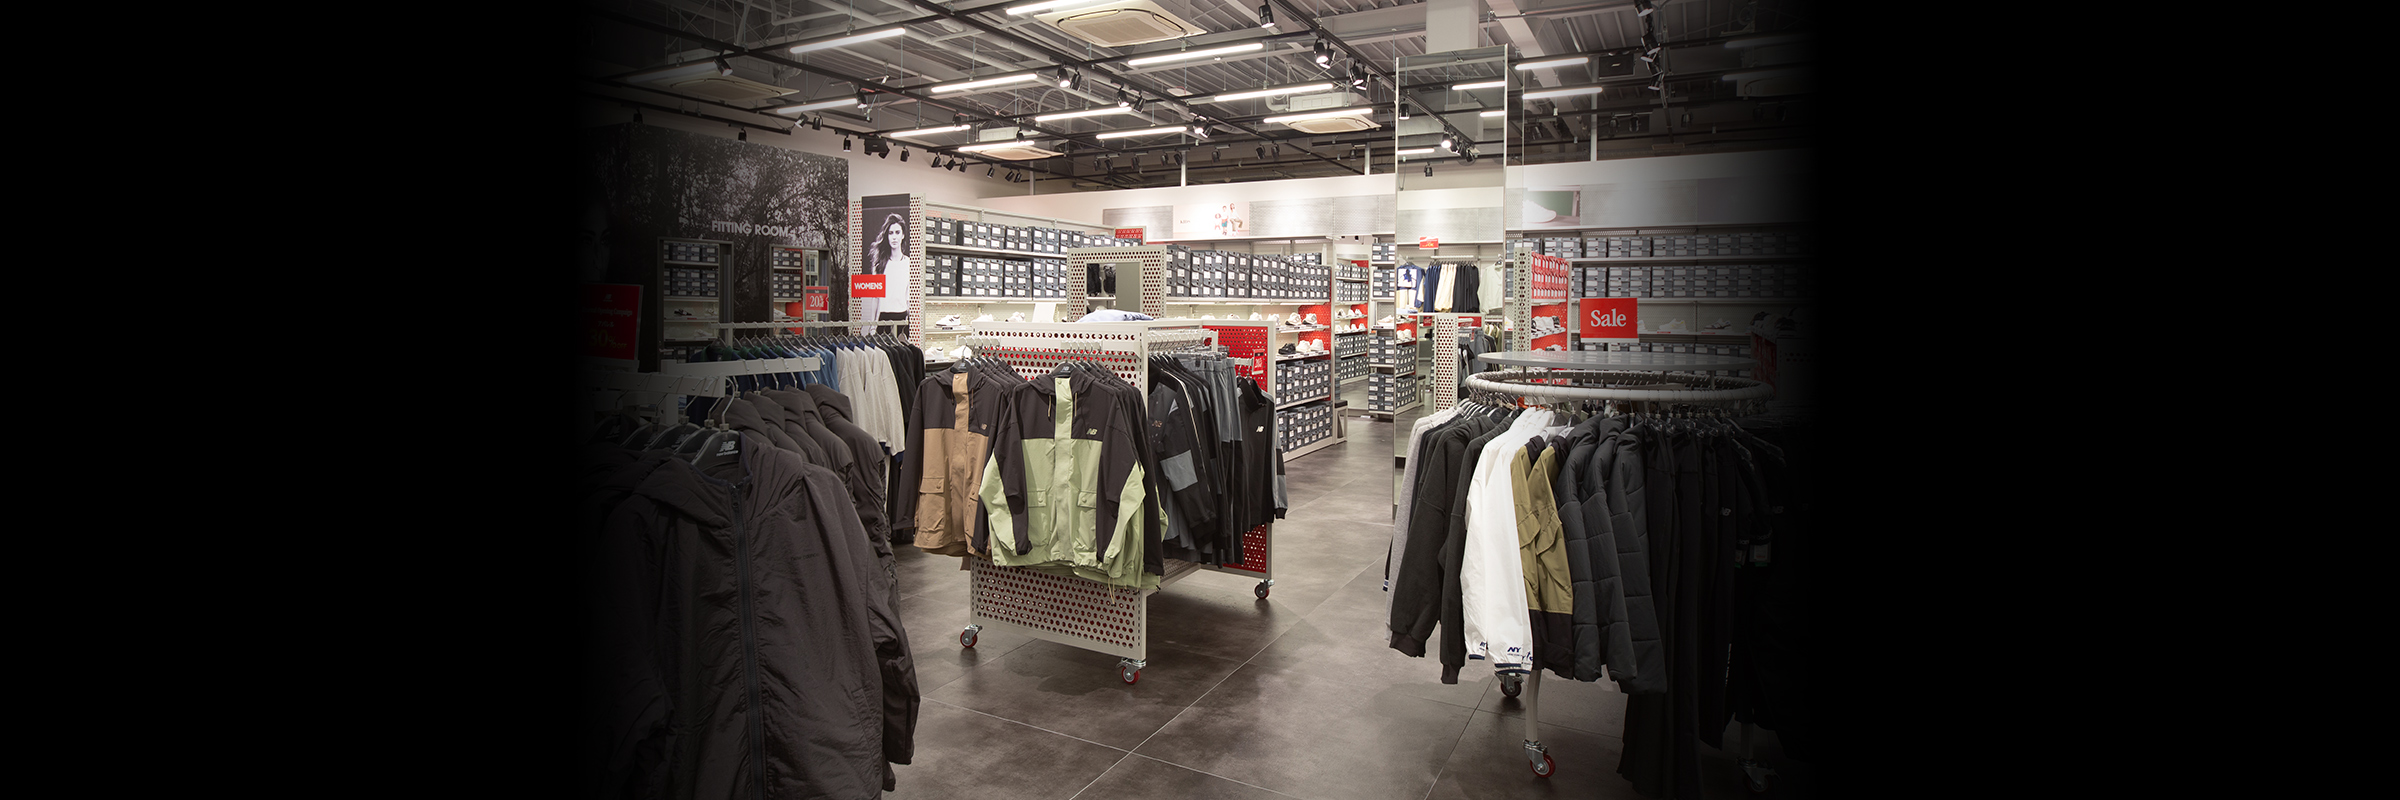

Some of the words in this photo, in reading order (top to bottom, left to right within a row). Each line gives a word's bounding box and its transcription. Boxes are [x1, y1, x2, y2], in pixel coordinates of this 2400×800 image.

[711, 220, 752, 237] FITTING
[754, 224, 789, 238] ROOM
[854, 282, 883, 290] WOMENS
[1590, 307, 1627, 328] Sale
